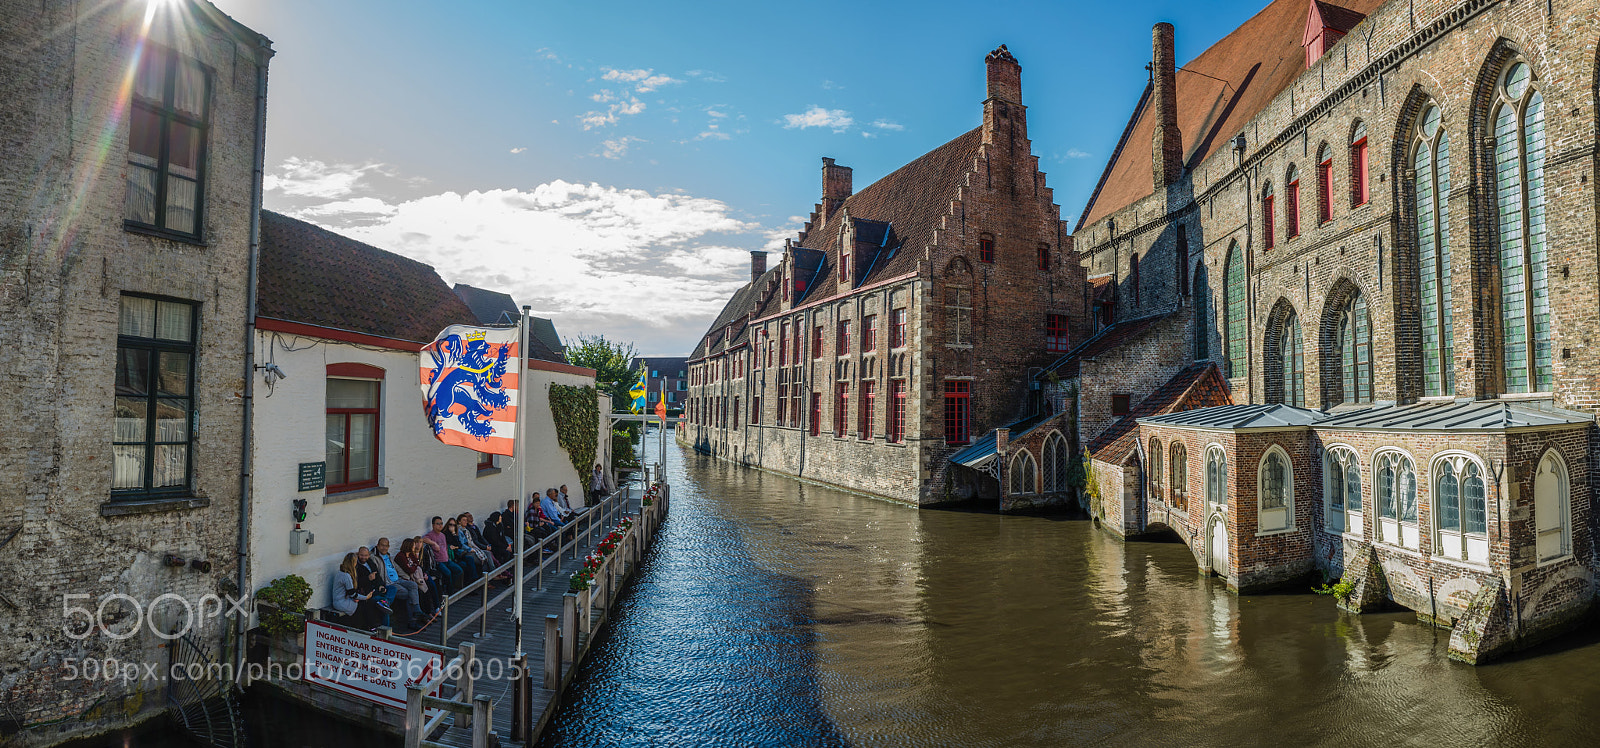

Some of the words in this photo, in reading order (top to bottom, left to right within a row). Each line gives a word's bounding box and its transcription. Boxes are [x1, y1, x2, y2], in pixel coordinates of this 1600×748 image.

[315, 640, 343, 654] ENTREE
[345, 648, 360, 659] DES
[361, 652, 399, 669] BATEAUX
[316, 630, 346, 645] INGANG
[347, 638, 370, 652] NAAR
[371, 645, 382, 654] DE
[383, 648, 412, 661] BOTEN
[315, 650, 350, 667] EINGANG
[351, 660, 369, 673] ZUM
[370, 666, 394, 678] BOOT
[315, 660, 339, 674] ENTRY
[341, 668, 352, 678] TO
[354, 671, 369, 682] THE
[370, 677, 397, 690] BOATS
